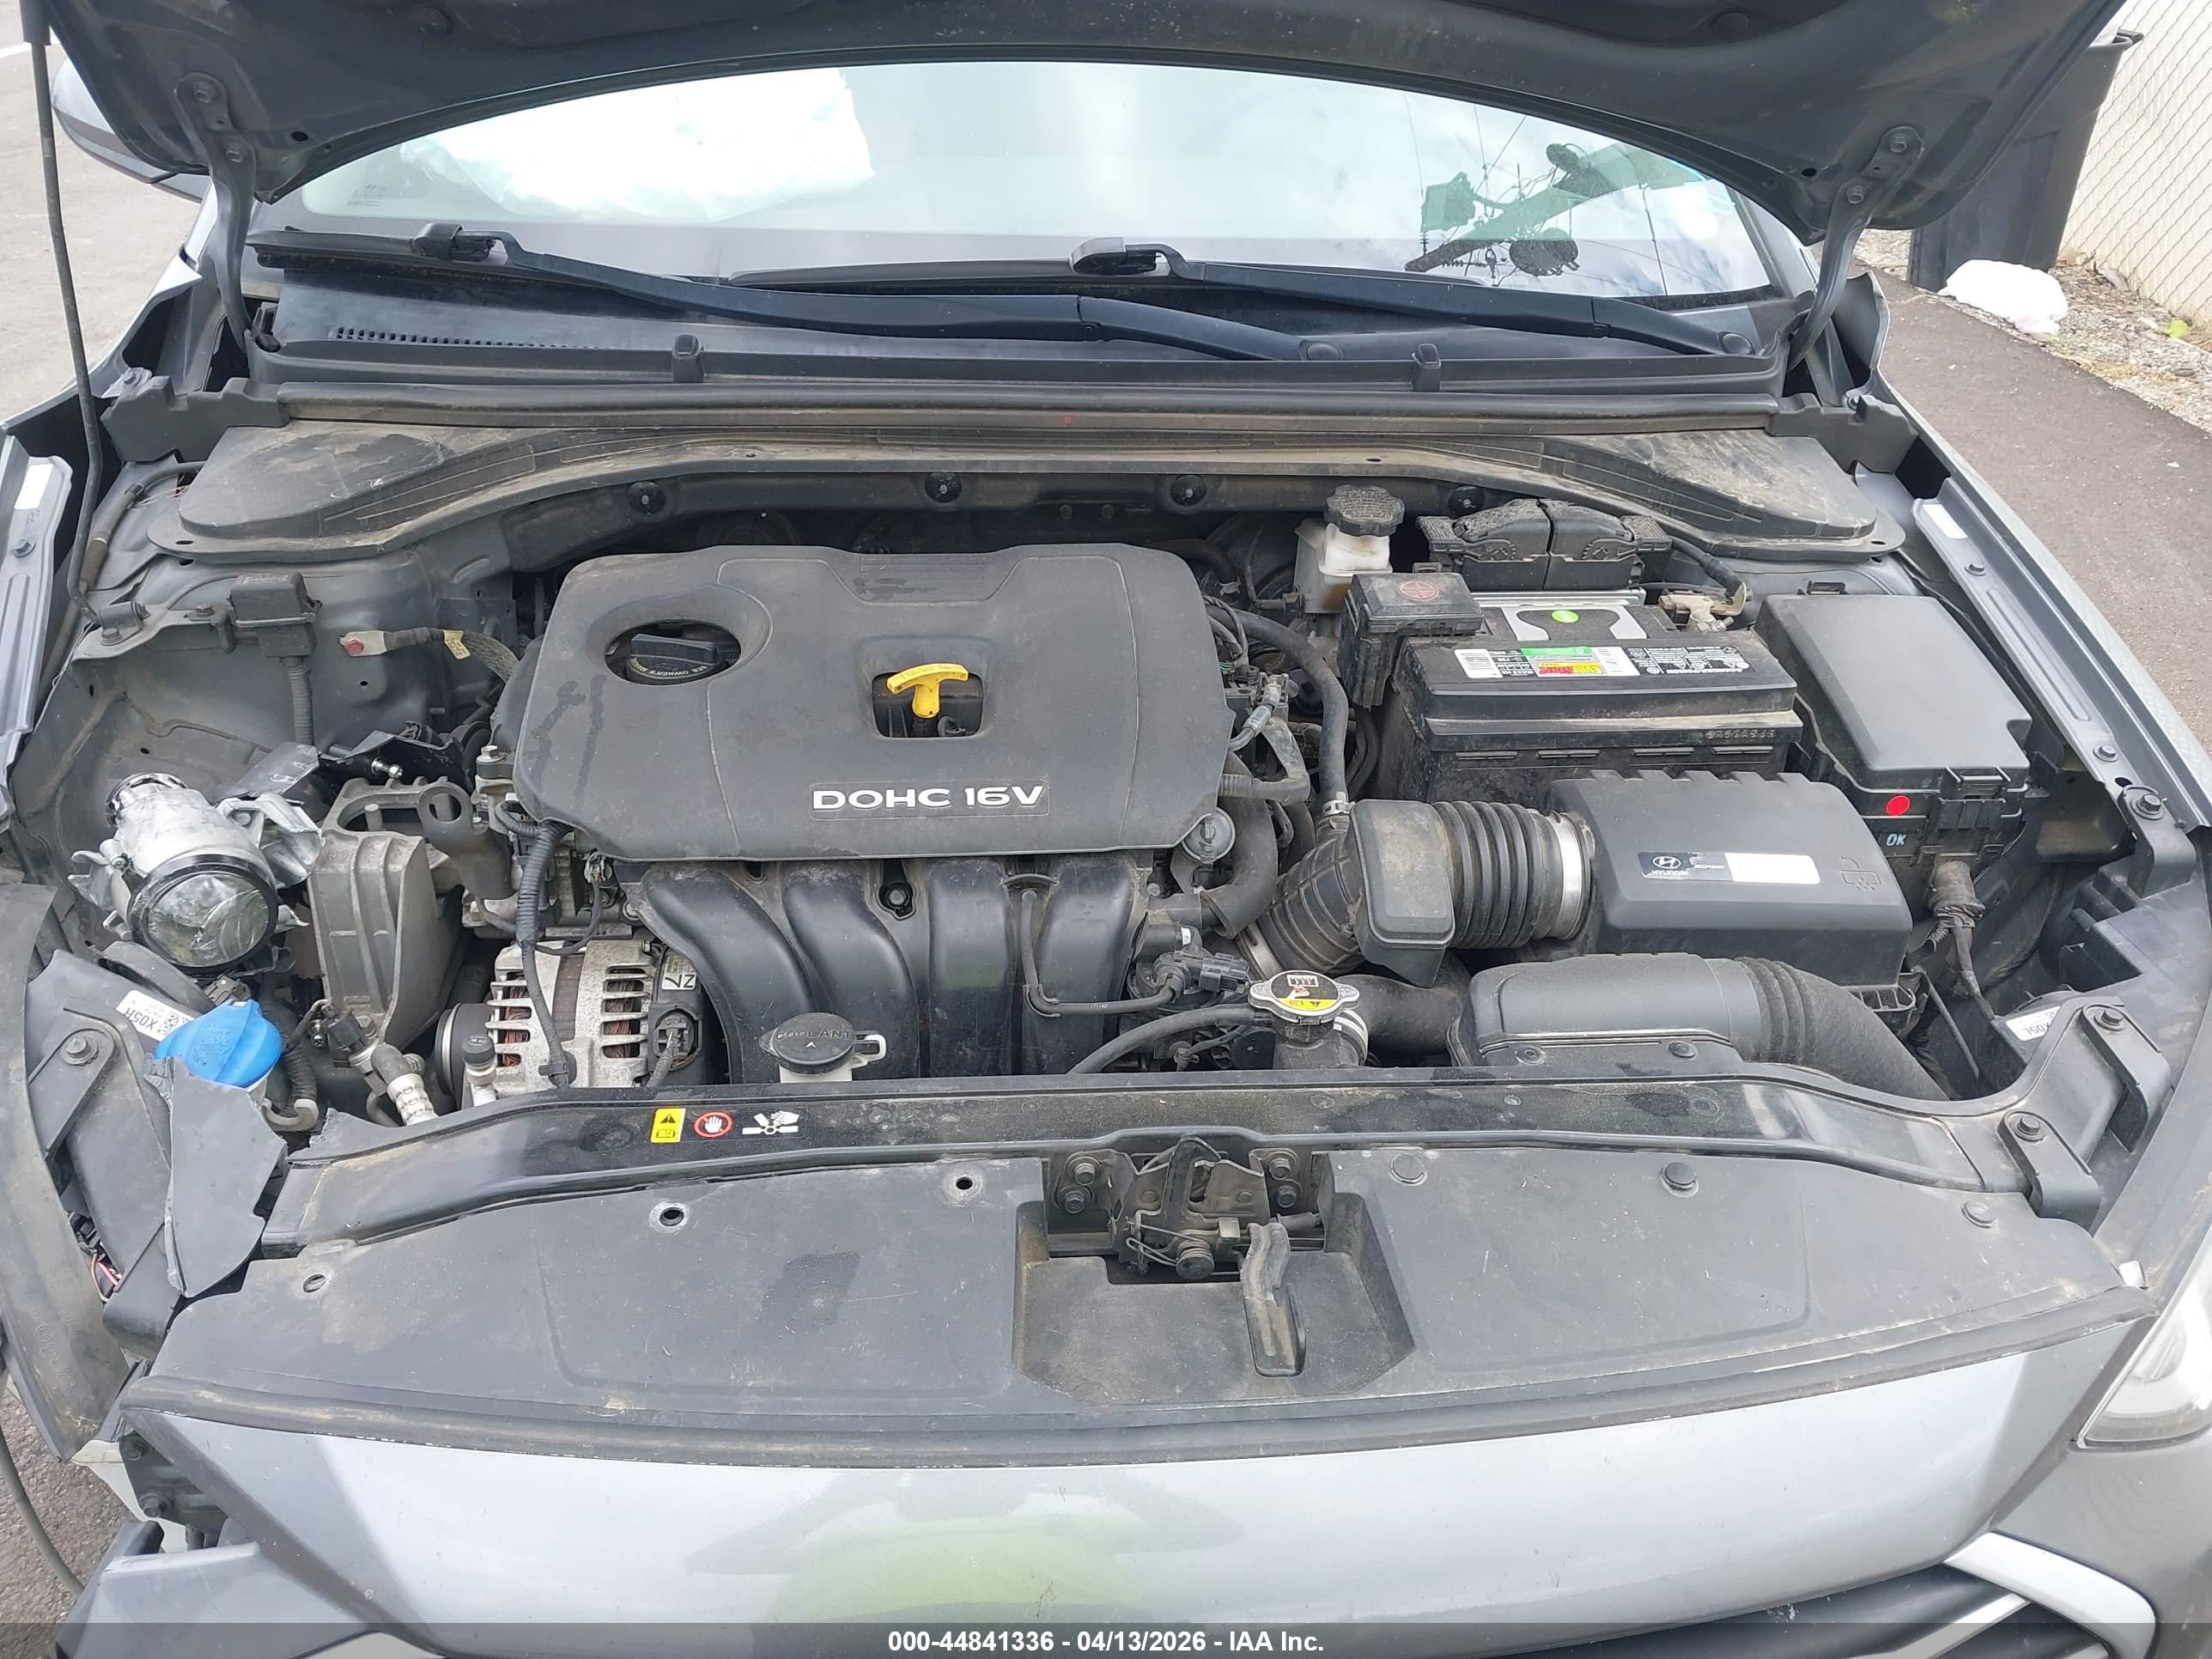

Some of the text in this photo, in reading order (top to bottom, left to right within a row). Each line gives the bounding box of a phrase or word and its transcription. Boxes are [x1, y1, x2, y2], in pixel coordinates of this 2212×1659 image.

[812, 786, 1044, 809] DOHC 16V
[1886, 833, 1907, 847] OK
[124, 1006, 159, 1030] X05R
[776, 1030, 851, 1040] COOLANT
